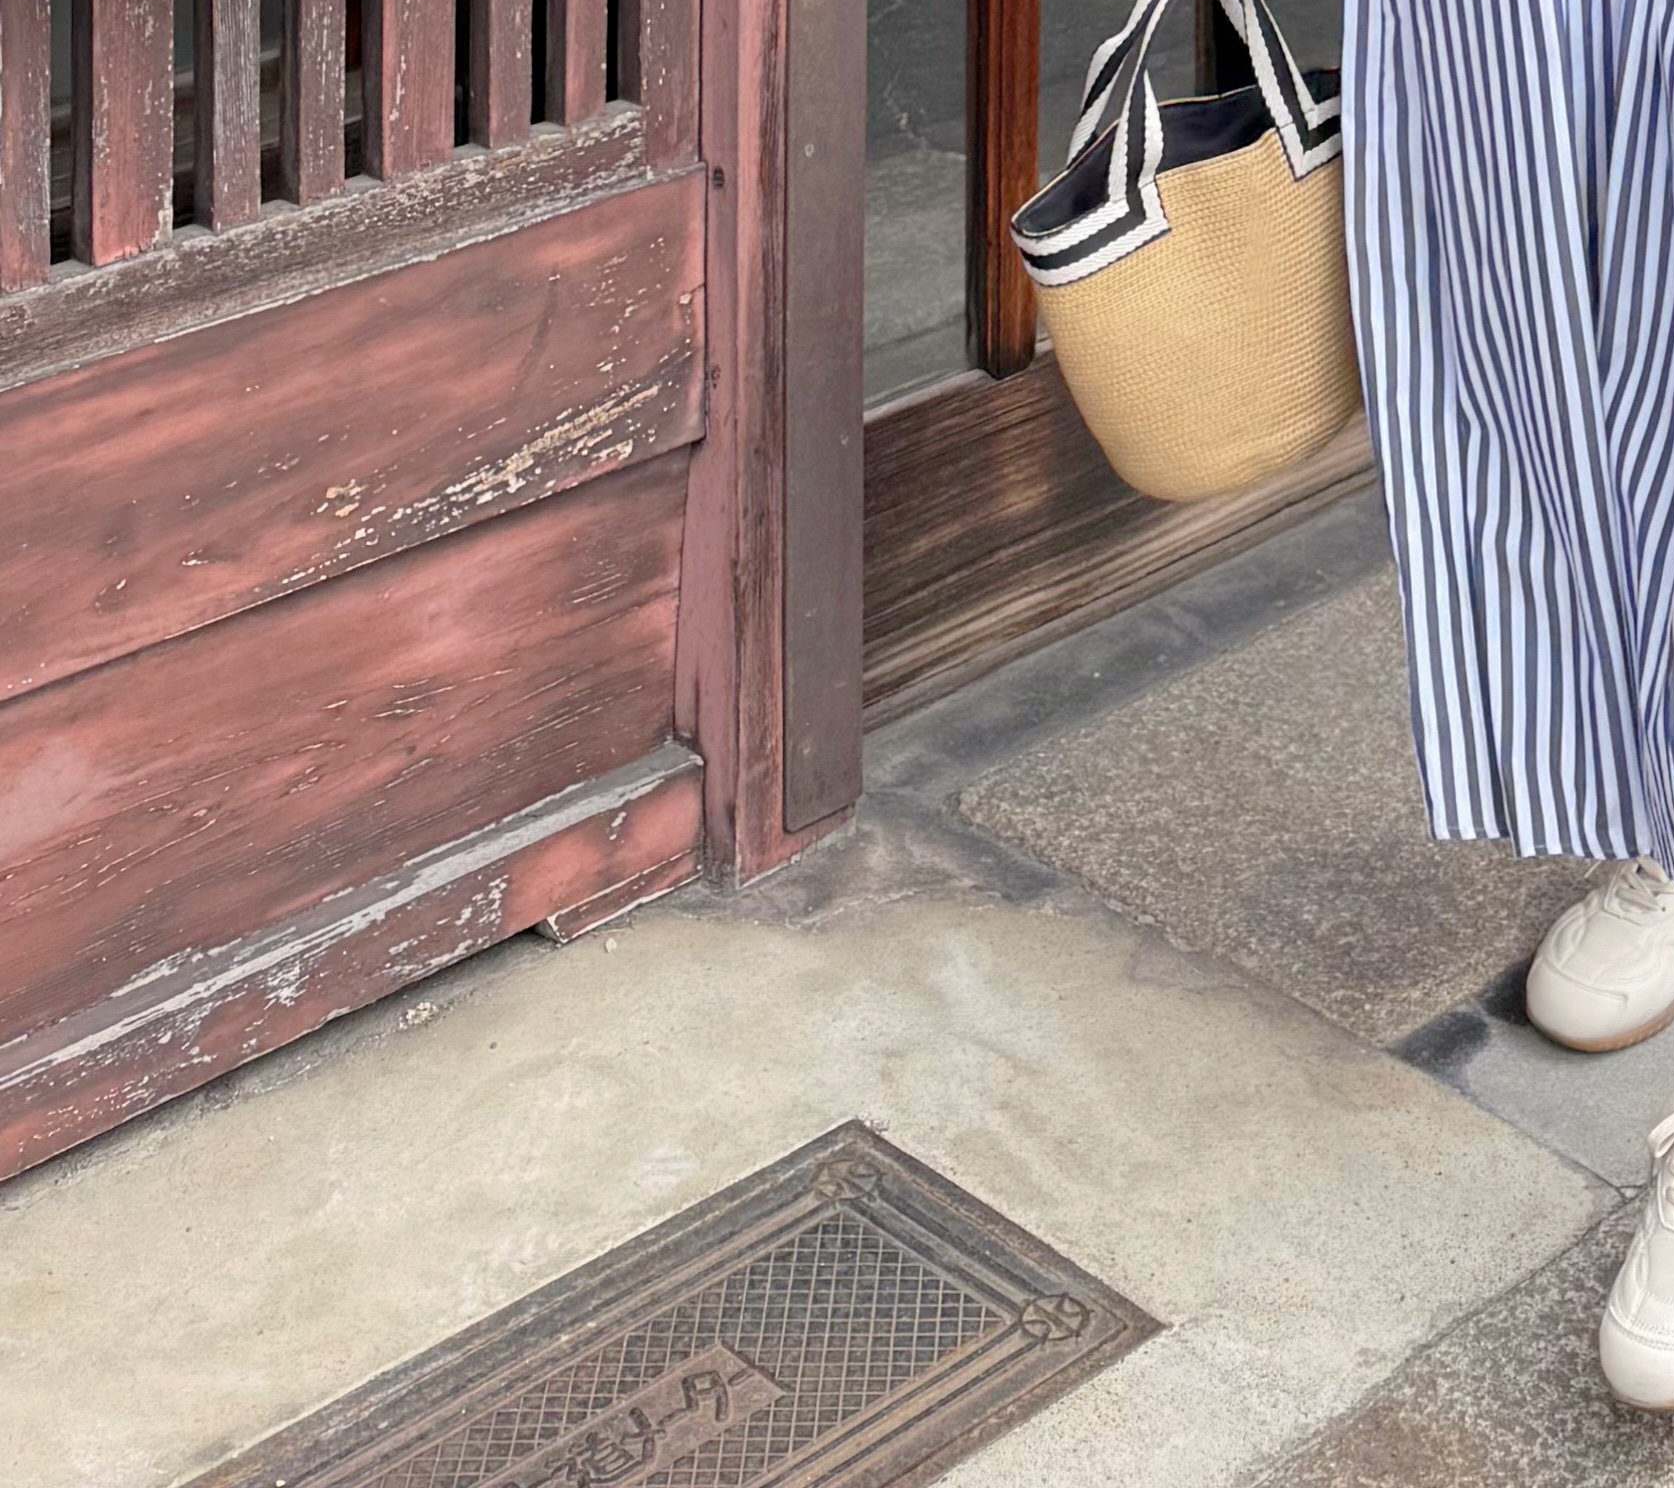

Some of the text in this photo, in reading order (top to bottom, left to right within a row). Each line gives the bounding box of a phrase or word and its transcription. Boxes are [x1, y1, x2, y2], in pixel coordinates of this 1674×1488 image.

[503, 1369, 753, 1488] 道メーター
